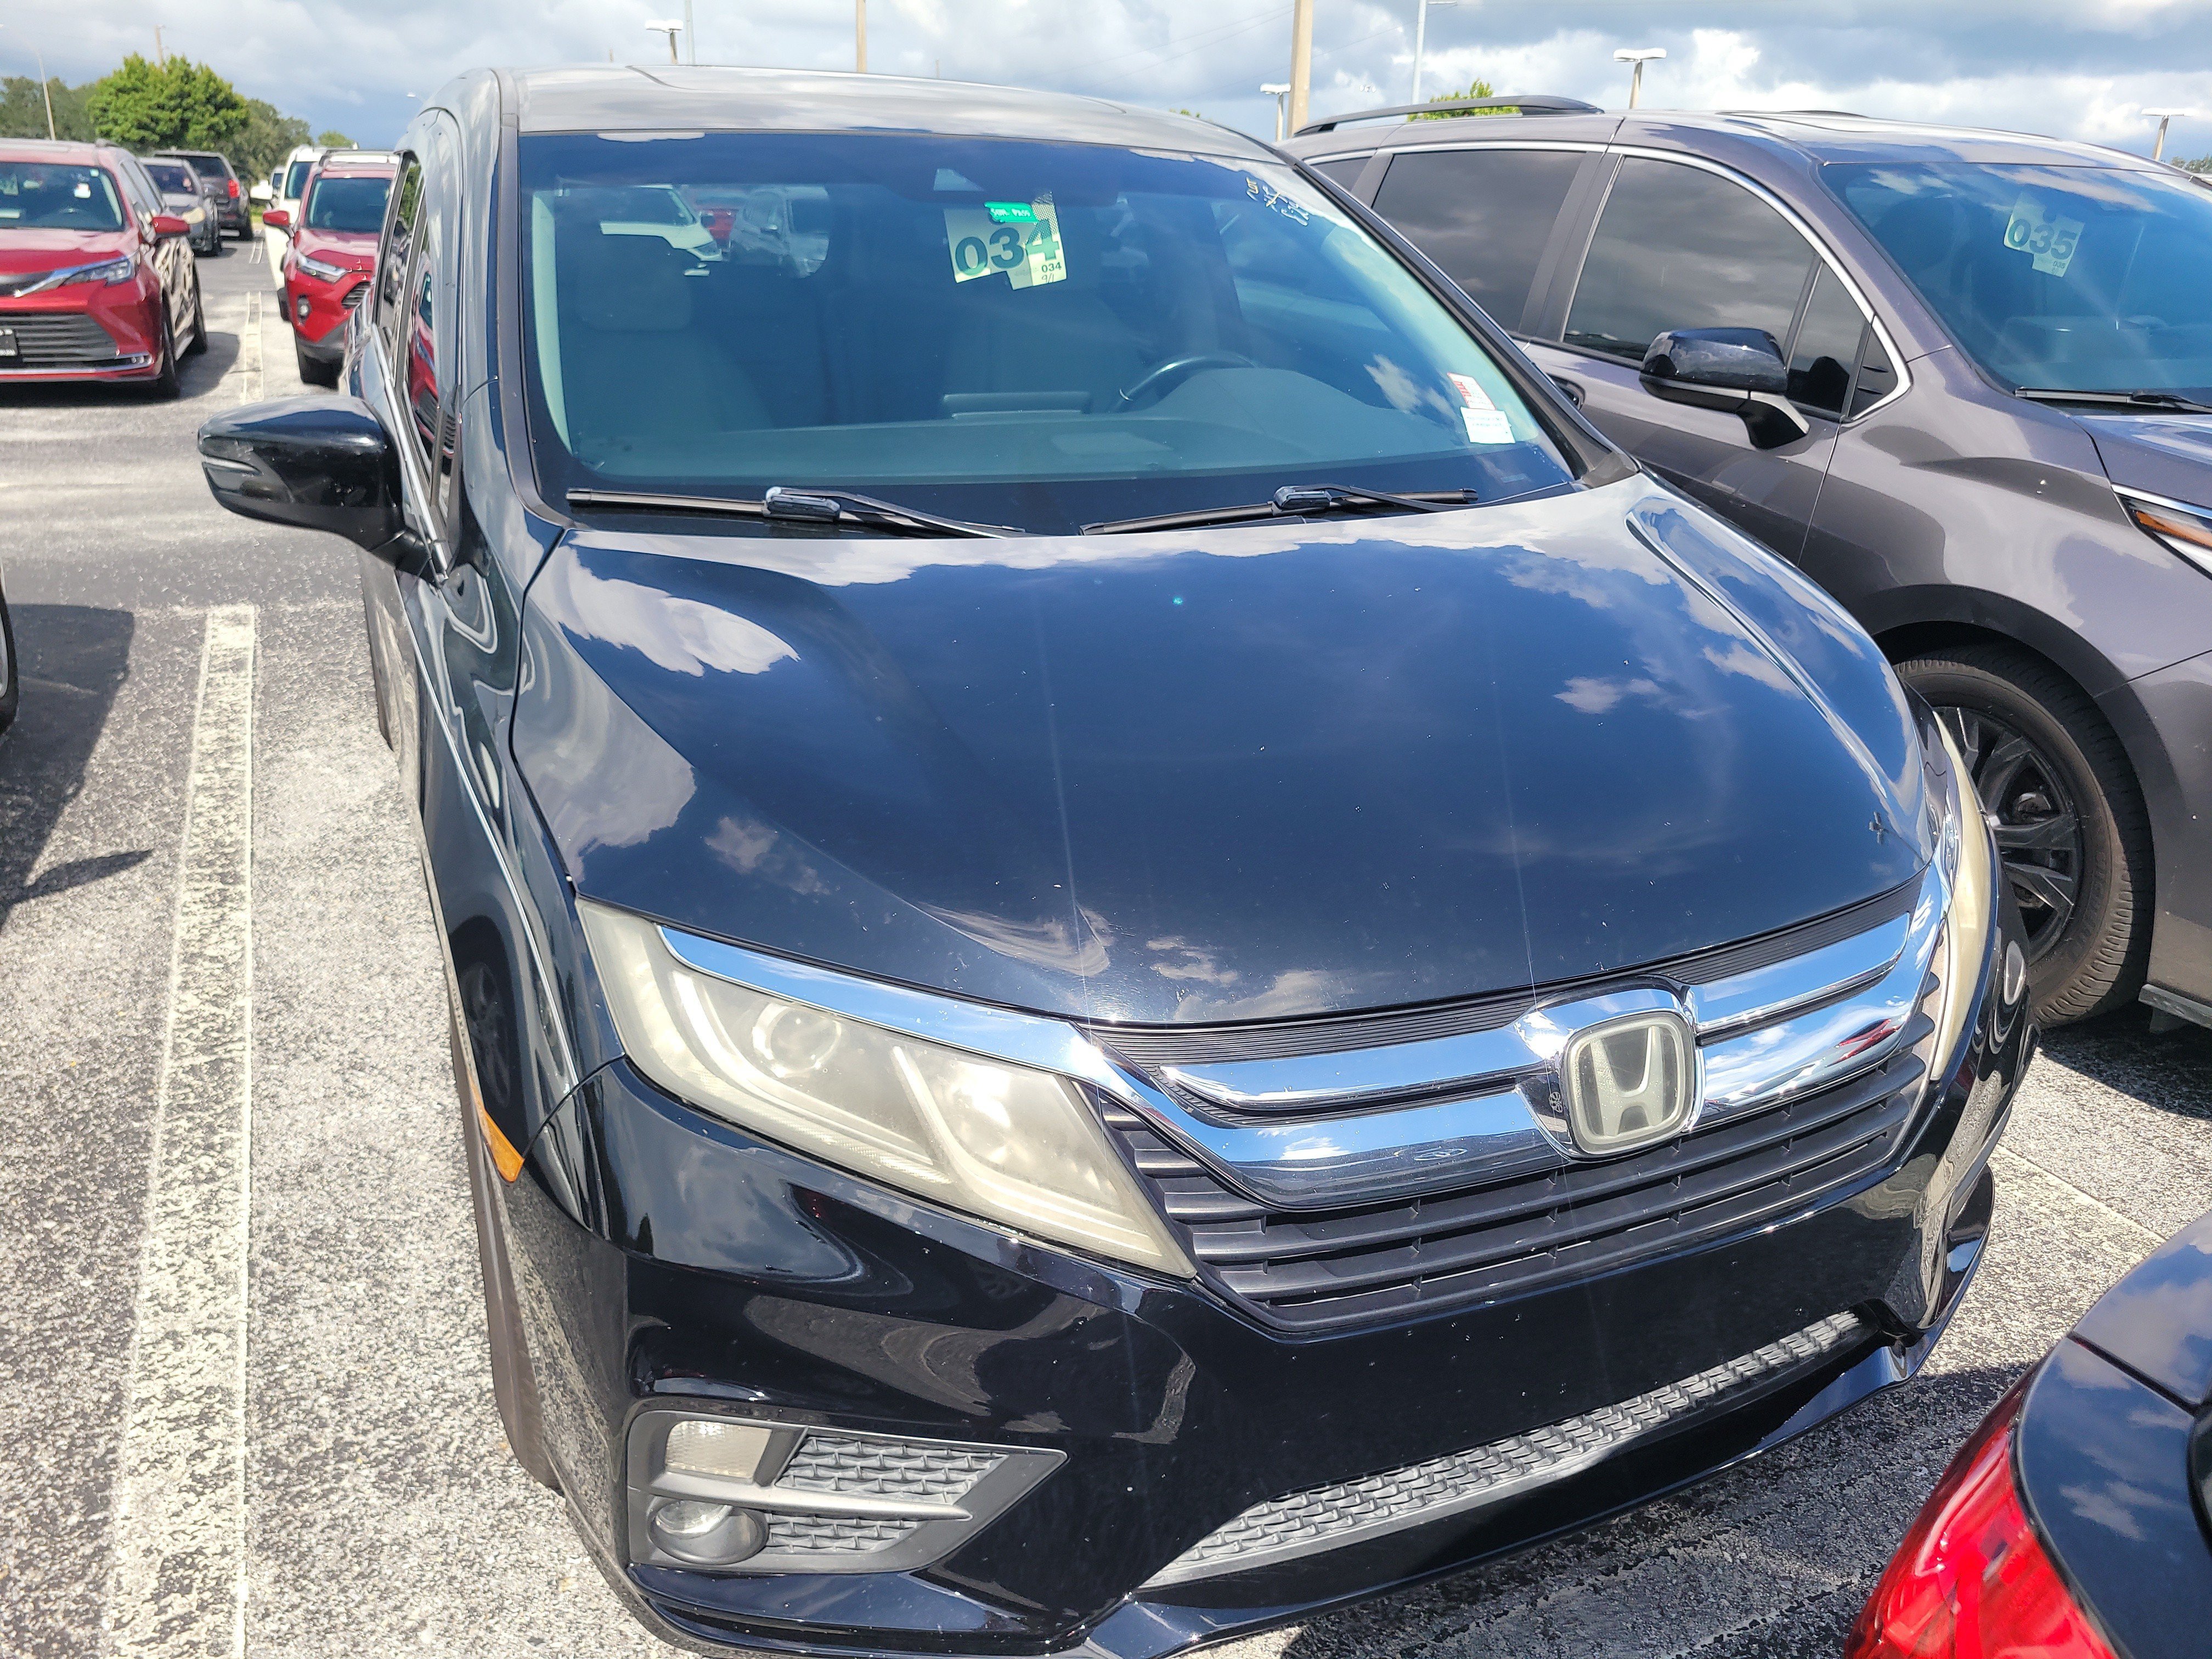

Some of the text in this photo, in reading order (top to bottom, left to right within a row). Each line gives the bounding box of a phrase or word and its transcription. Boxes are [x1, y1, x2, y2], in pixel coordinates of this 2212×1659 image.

[955, 219, 1060, 276] 034
[2008, 219, 2077, 259] 035
[1041, 262, 1062, 273] 034
